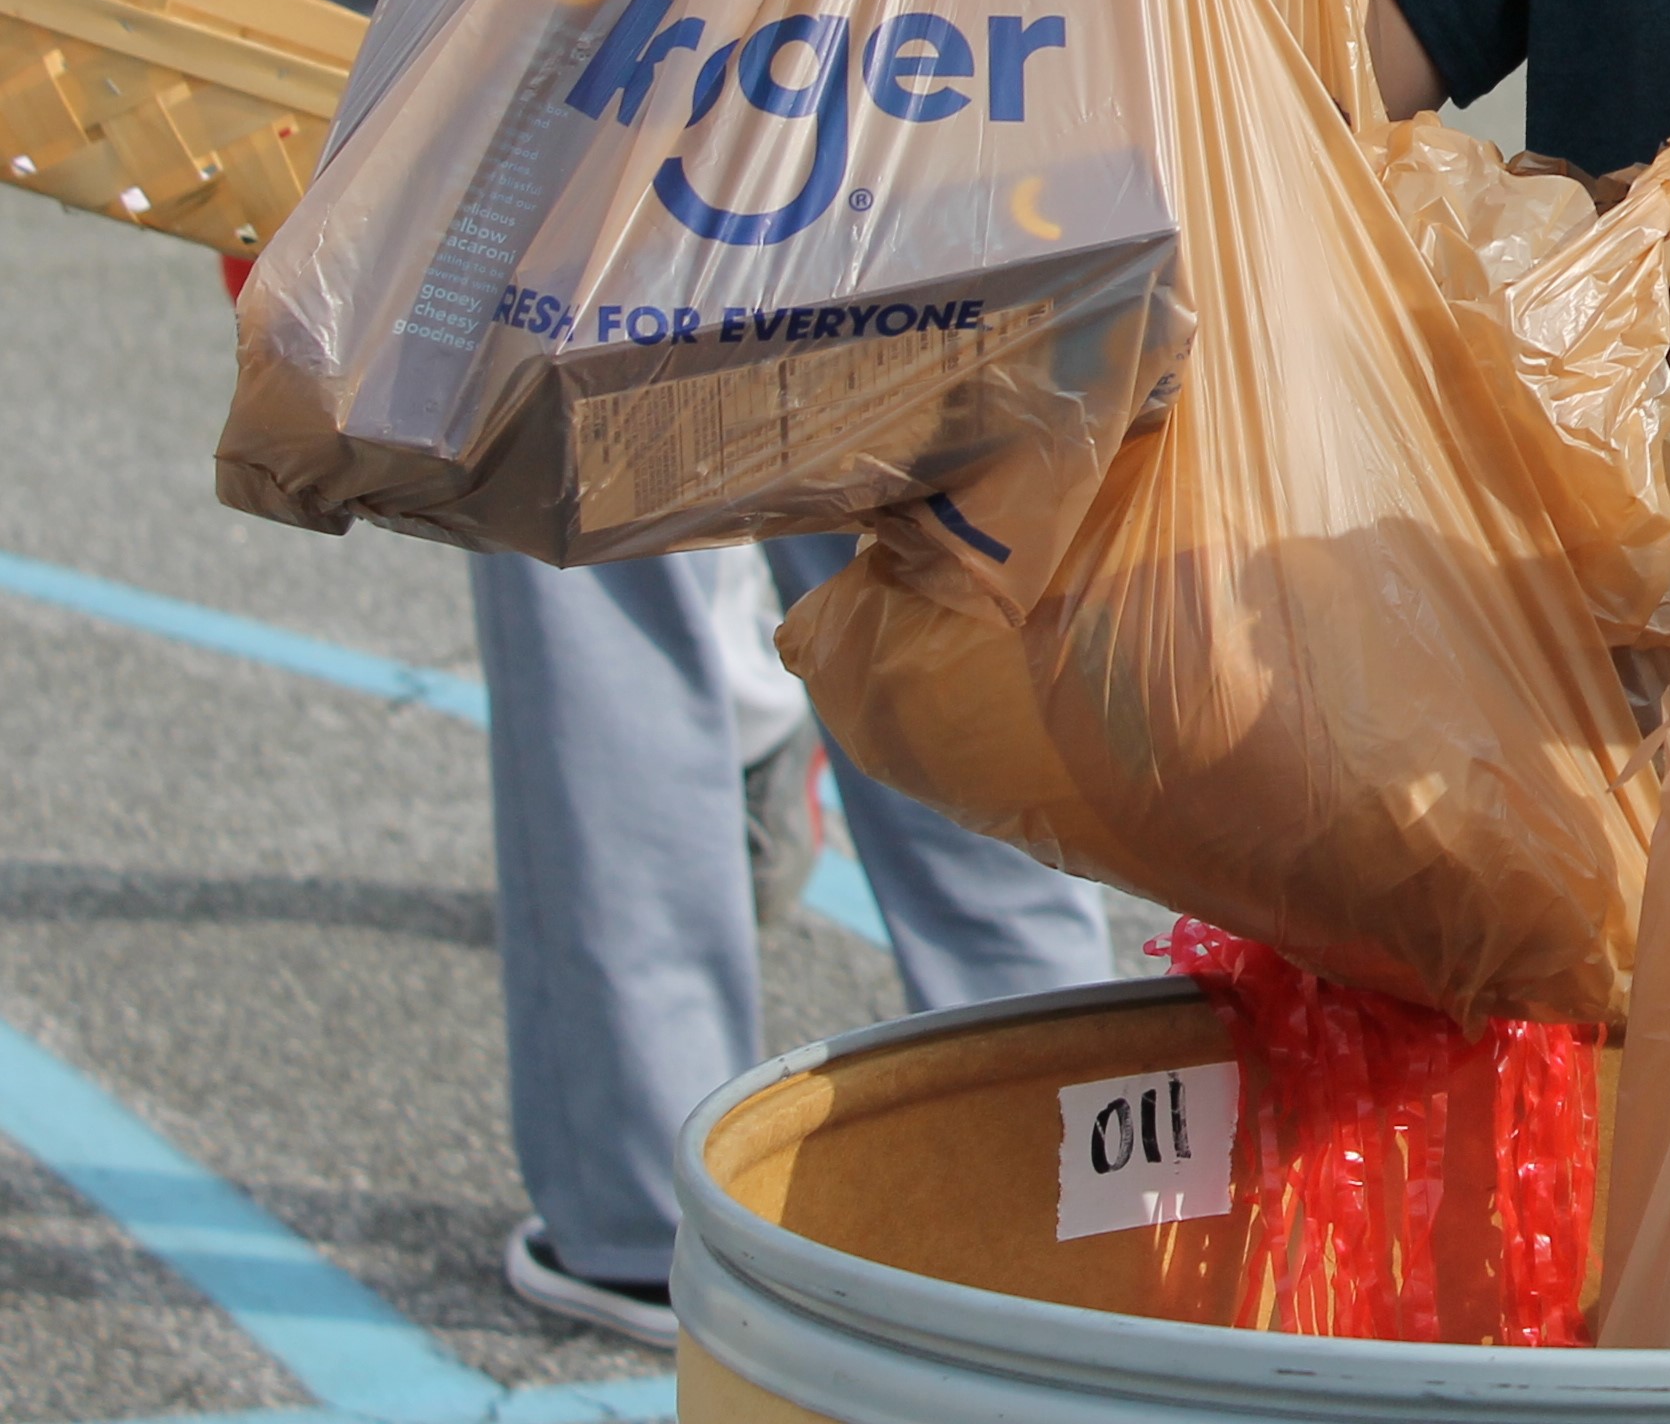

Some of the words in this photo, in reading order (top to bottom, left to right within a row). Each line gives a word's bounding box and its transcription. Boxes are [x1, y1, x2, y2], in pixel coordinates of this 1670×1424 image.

[516, 200, 537, 211] our
[429, 251, 471, 271] aiting
[437, 231, 518, 265] acaroni
[420, 283, 483, 314] gooey,
[472, 278, 499, 295] with
[414, 301, 480, 335] cheesy
[492, 284, 580, 343] RESH
[598, 305, 701, 345] FOR
[719, 299, 985, 343] EVERYONE
